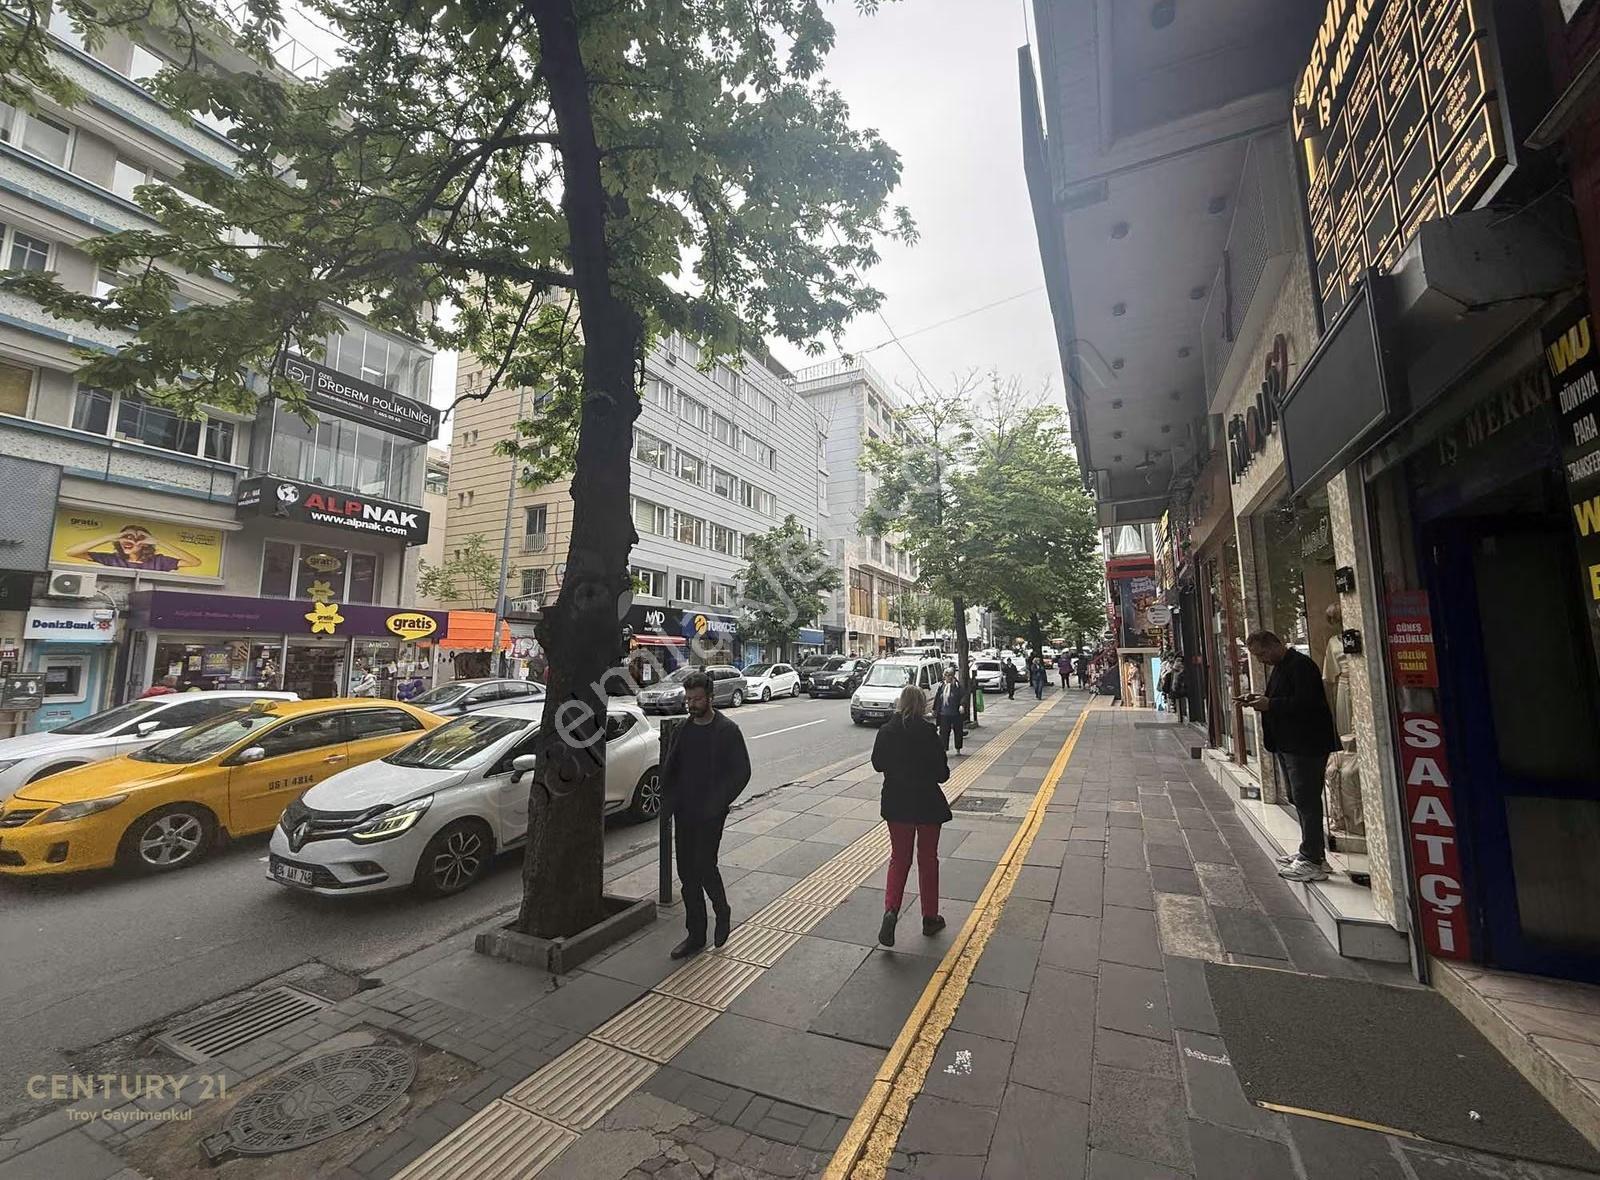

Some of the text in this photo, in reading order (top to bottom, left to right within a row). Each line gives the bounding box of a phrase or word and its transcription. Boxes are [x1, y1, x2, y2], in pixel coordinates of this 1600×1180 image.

[317, 377, 369, 404] DRDERM
[1559, 370, 1598, 415] DÜNYAYA
[1573, 412, 1598, 447] PARA
[70, 516, 99, 527] gratis
[304, 492, 418, 529] ALPNAK
[311, 511, 407, 537] www.alpnak.com
[32, 619, 95, 630] DenizBank
[393, 616, 432, 631] gratis
[1403, 718, 1463, 953] SAATÇİ
